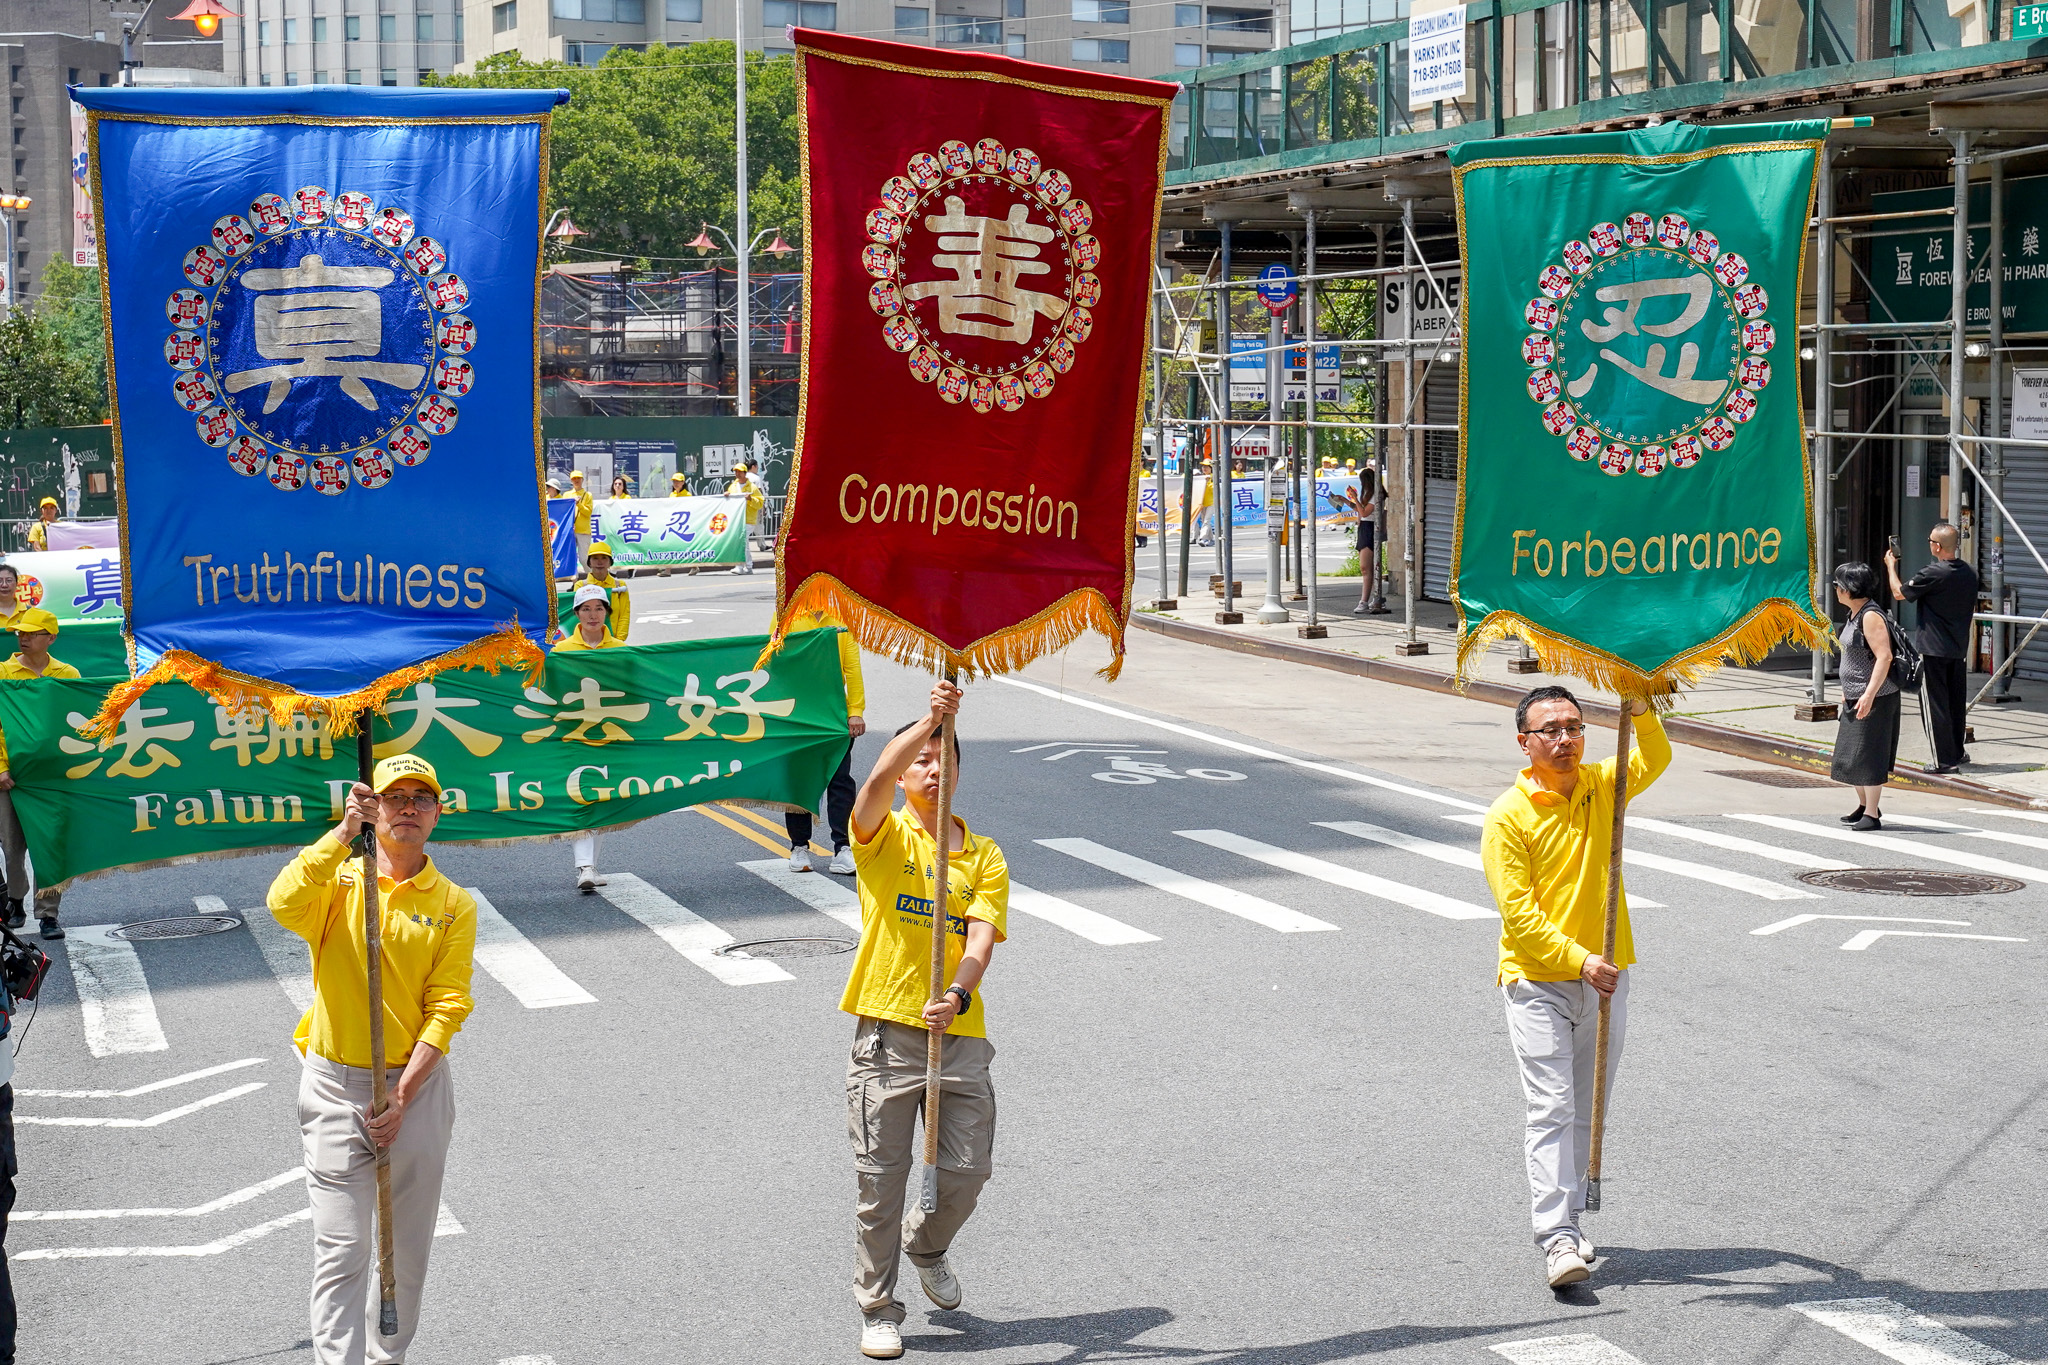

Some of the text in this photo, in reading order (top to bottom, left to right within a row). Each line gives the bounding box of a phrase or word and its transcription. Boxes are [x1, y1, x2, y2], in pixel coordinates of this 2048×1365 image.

[1418, 15, 1436, 36] BROADWAY
[2019, 9, 2027, 26] E
[1414, 40, 1460, 63] YARKS NYC INC
[1414, 60, 1461, 82] 718-581-7608
[903, 196, 1068, 344] 善
[1919, 271, 1967, 287] FOREV
[2015, 263, 2048, 281] PHAR
[1260, 296, 1294, 308] NO STANDING
[225, 254, 426, 414] 真
[1568, 273, 1728, 405] 忍
[1293, 357, 1307, 367] 13
[1315, 357, 1337, 367] M22
[2022, 377, 2043, 388] FOREVER
[839, 473, 1079, 540] Compassion
[1511, 526, 1783, 578] Forbearance
[183, 551, 487, 610] Truthfulness
[387, 759, 410, 768] Falun
[129, 788, 307, 834] Falun
[488, 770, 545, 813] Is
[899, 896, 935, 914] FALU
